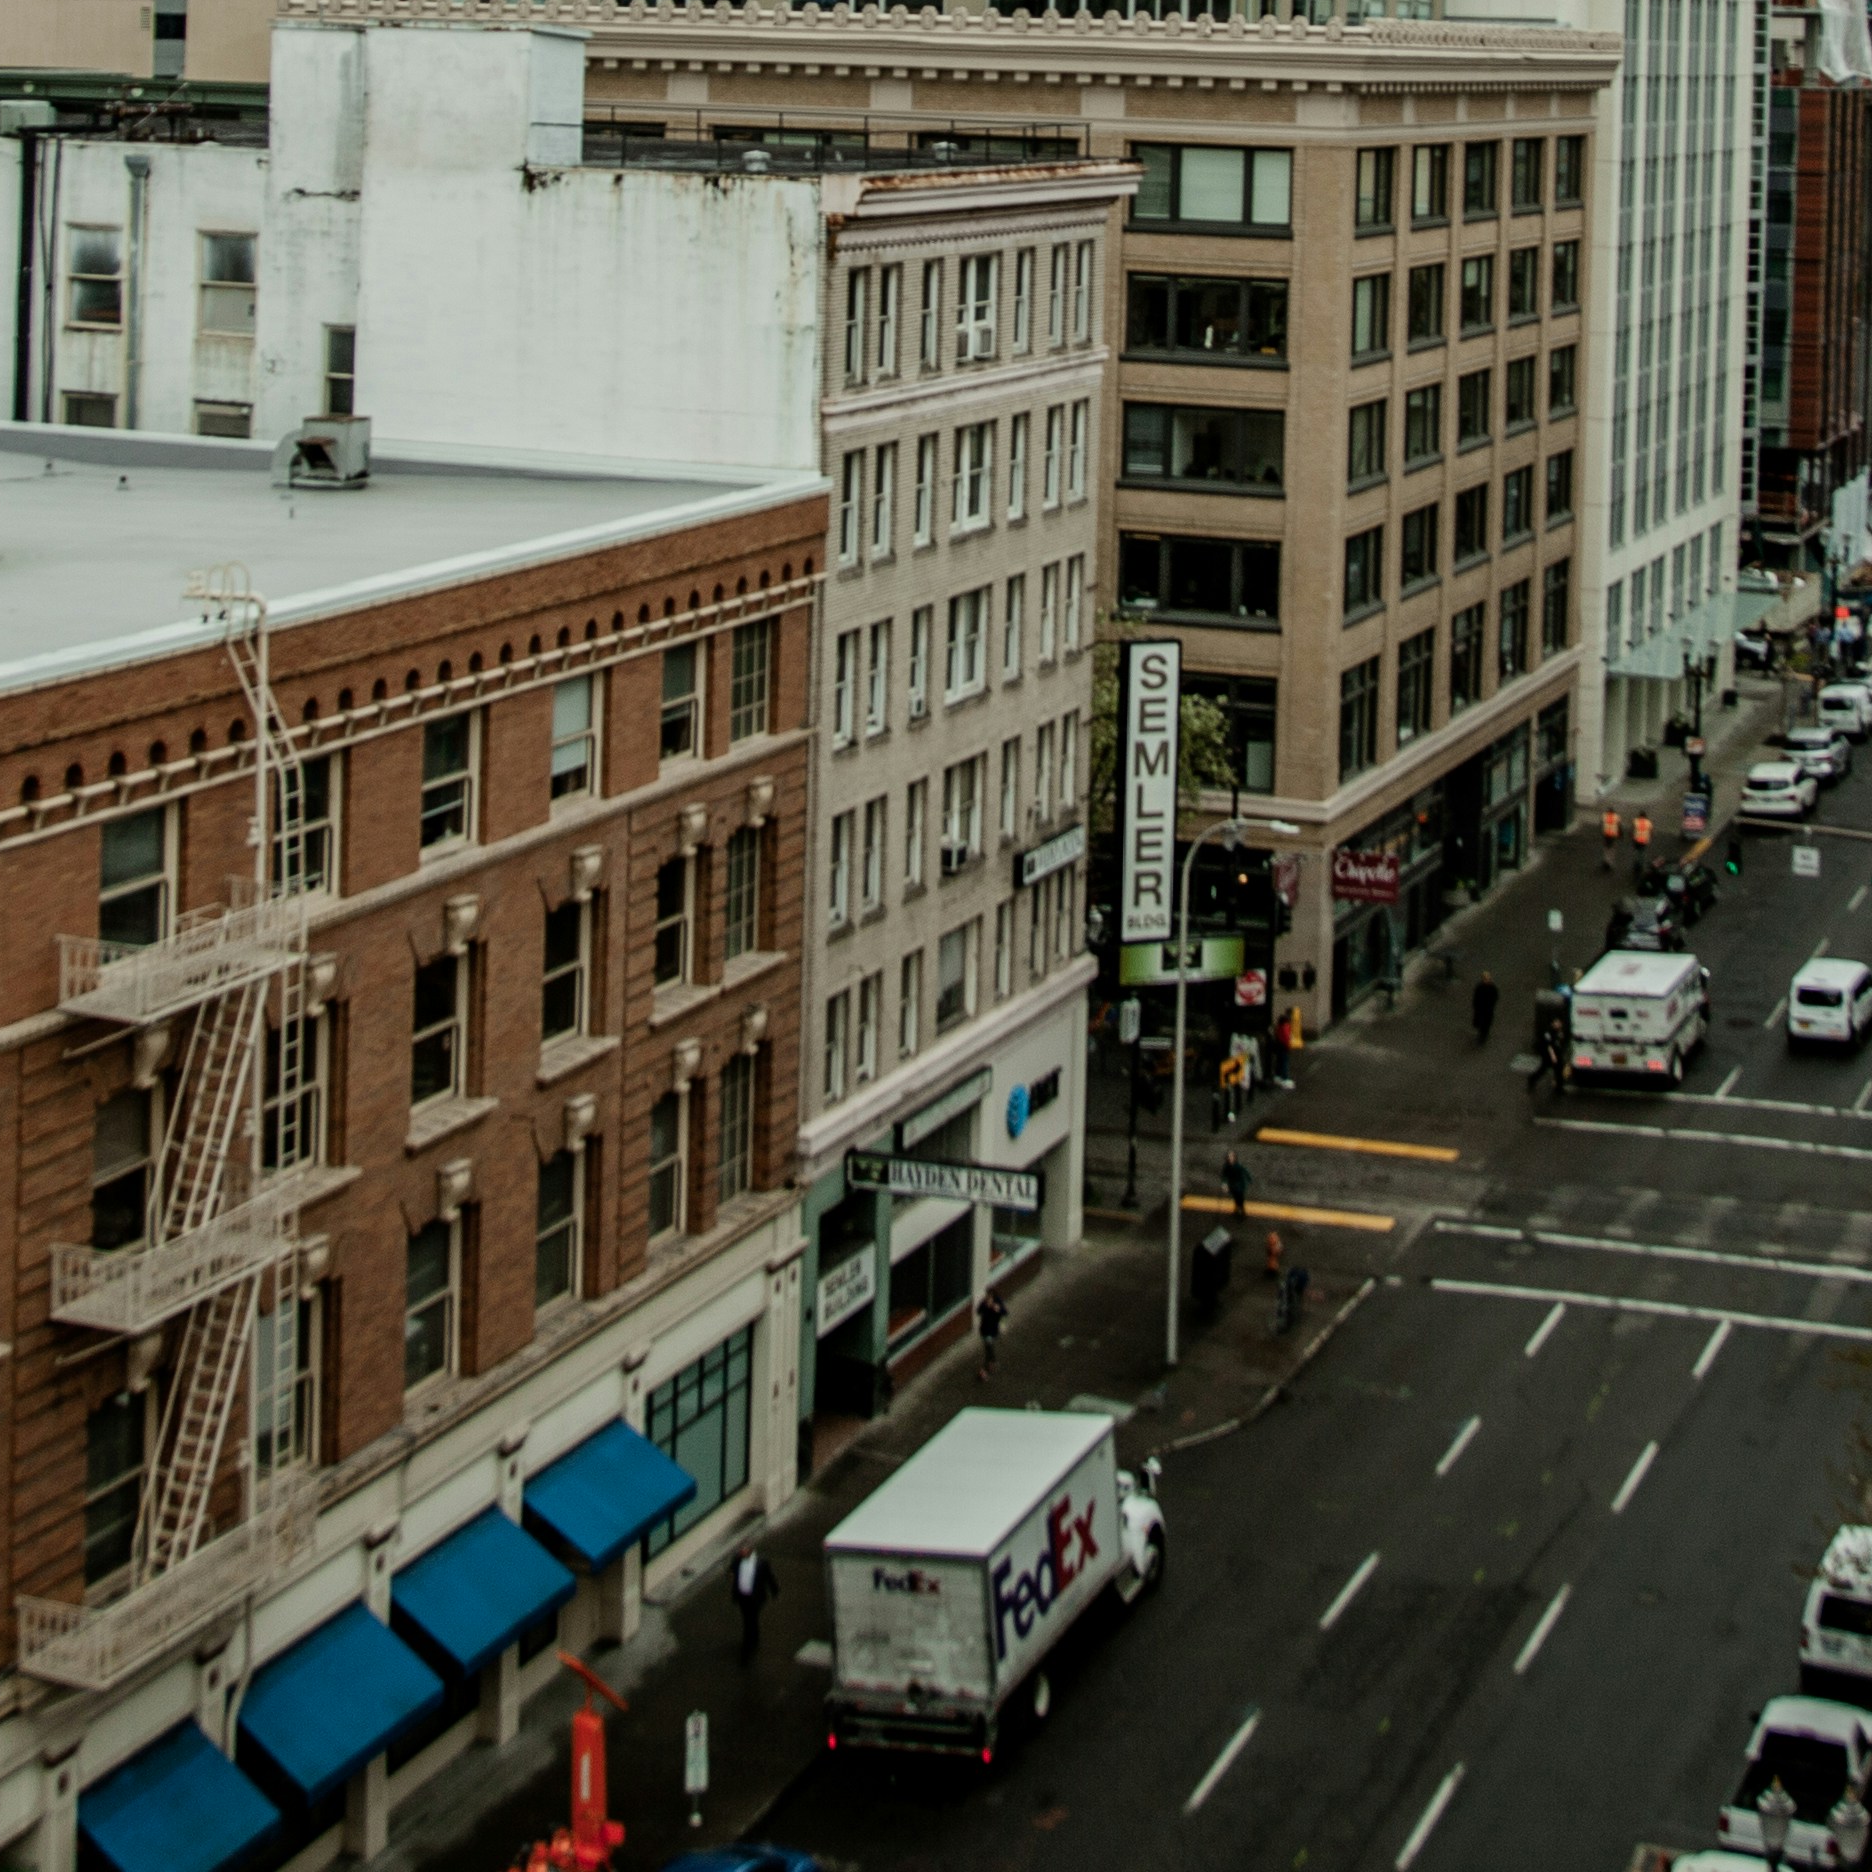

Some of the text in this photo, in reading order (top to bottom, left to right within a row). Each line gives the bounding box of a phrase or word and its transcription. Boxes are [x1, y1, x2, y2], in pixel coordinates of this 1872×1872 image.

[1133, 653, 1170, 908] SEMLER
[891, 1160, 1033, 1198] HAYDEN DENTAL
[873, 1567, 940, 1595] FedEx
[993, 1494, 1099, 1662] FedEx
